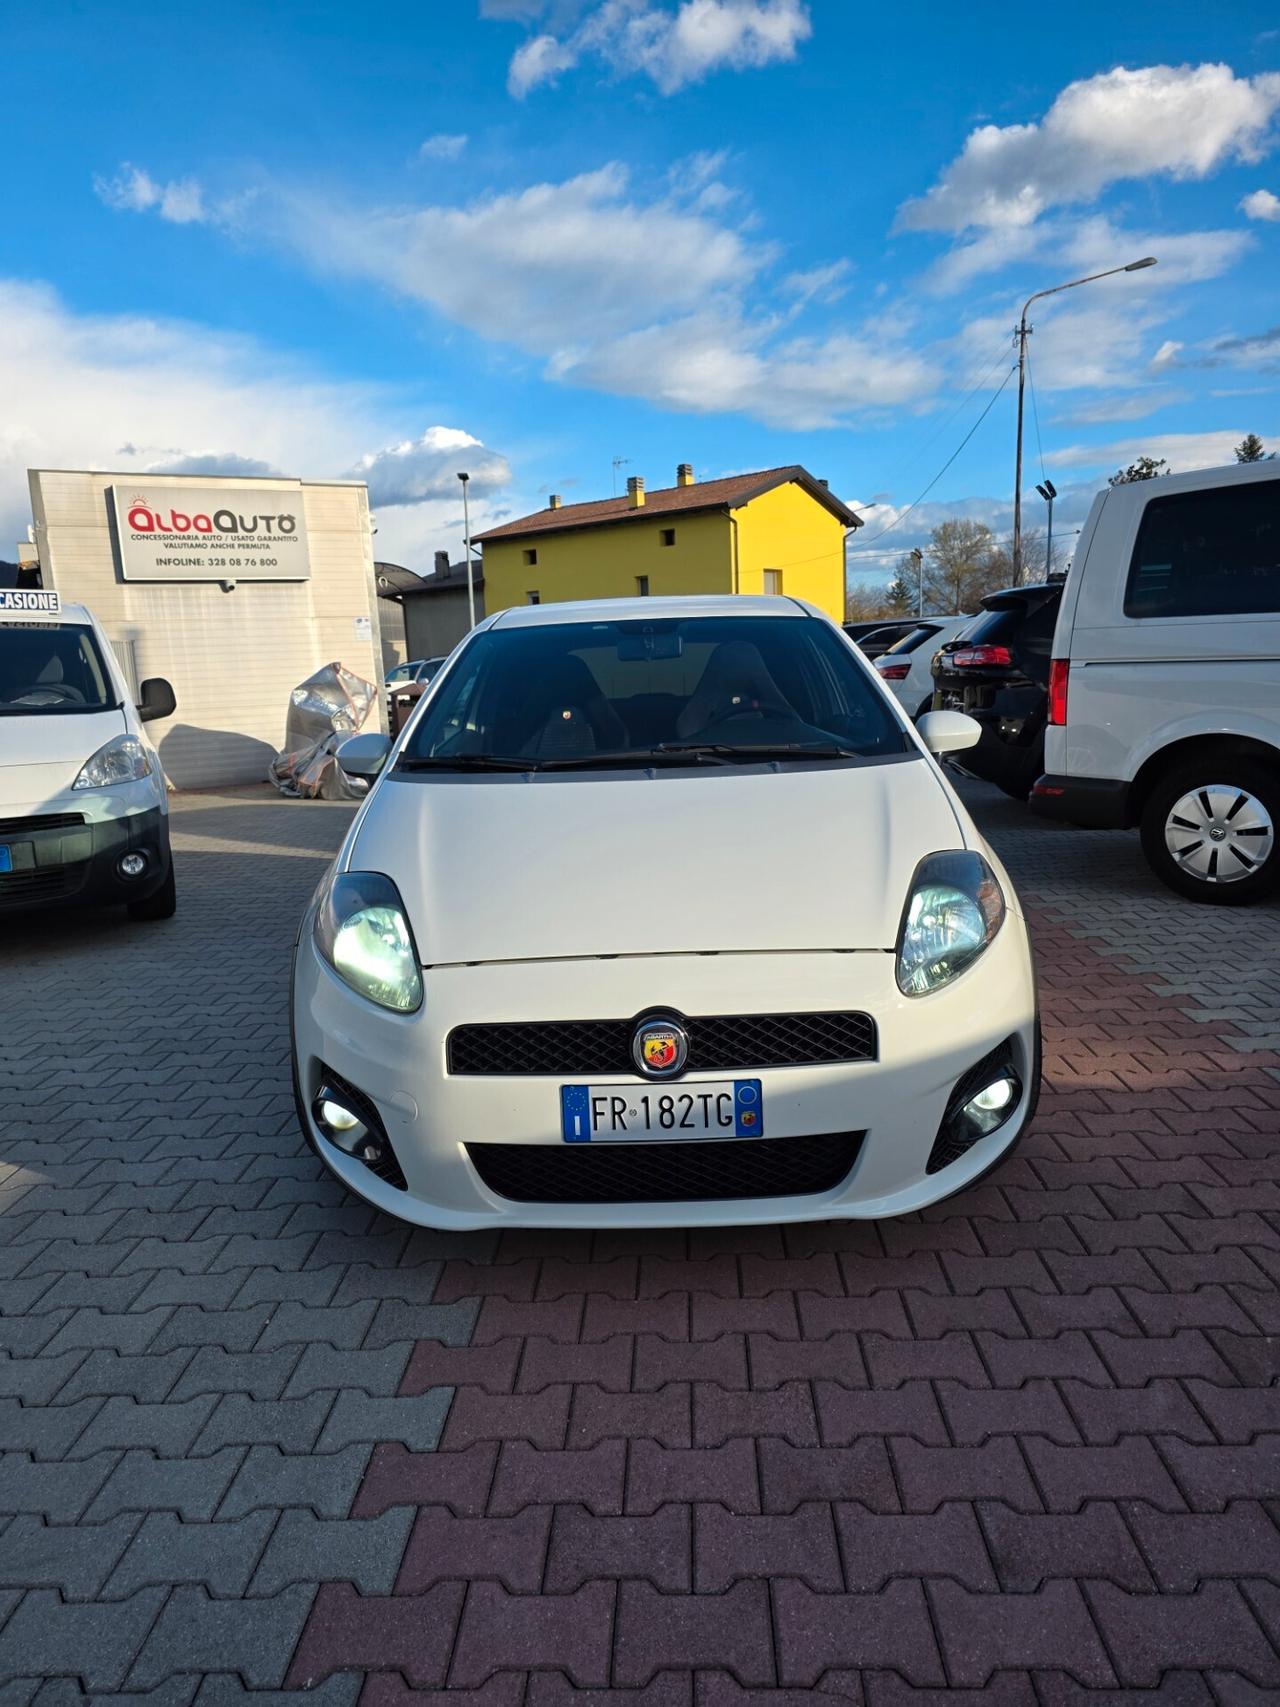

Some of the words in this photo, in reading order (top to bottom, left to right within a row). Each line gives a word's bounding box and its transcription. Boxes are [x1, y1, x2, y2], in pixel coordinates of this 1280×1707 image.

[156, 558, 205, 566] INFOLINE:
[207, 558, 226, 567] 328
[229, 558, 242, 567] 08
[244, 558, 257, 567] 76
[259, 559, 278, 567] 800
[592, 1096, 628, 1131] FR
[641, 1093, 733, 1130] 182TG
